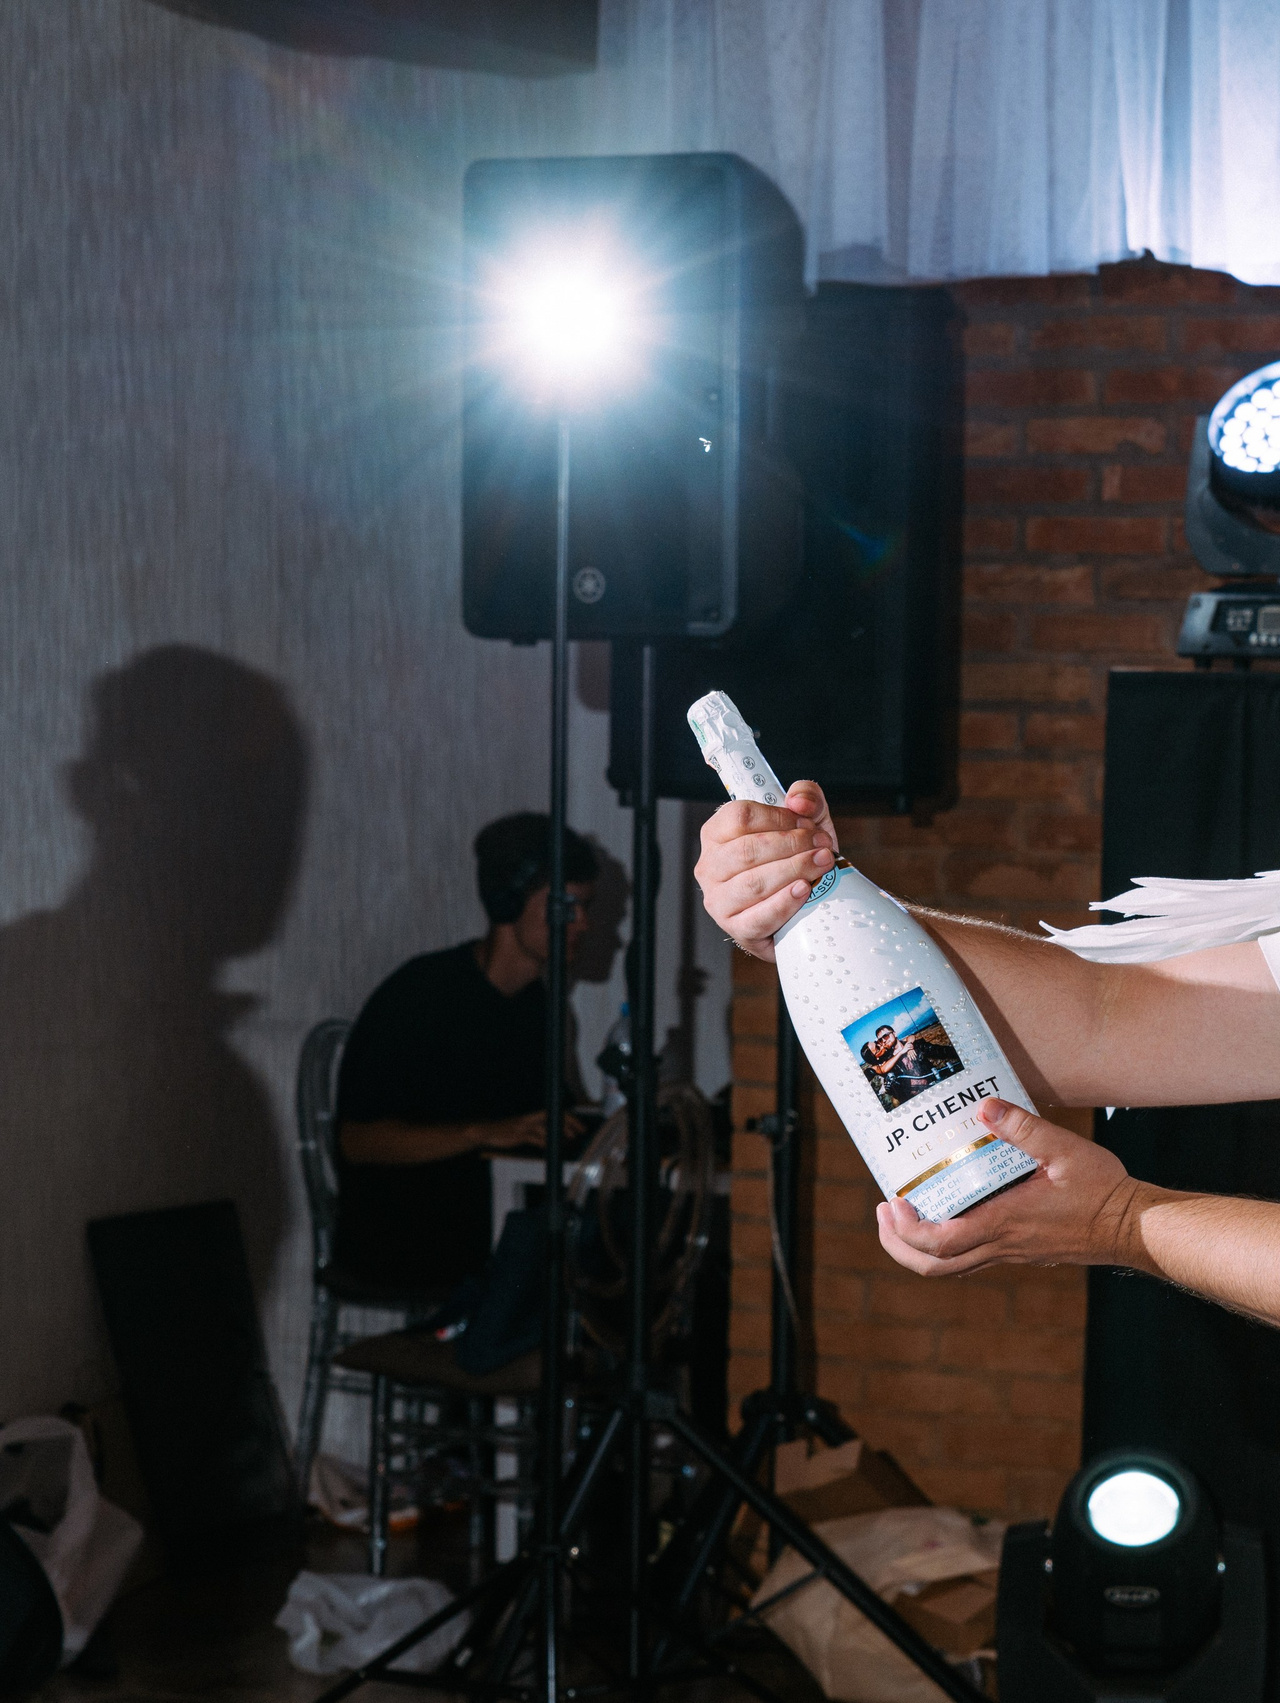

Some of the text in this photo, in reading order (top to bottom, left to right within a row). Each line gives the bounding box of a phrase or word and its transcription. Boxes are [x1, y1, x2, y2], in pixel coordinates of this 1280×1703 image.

[885, 1076, 1000, 1153] JP. CHENET
[911, 1142, 934, 1160] ICE
[1000, 1145, 1018, 1158] CHE
[1009, 1157, 1036, 1175] CHENE
